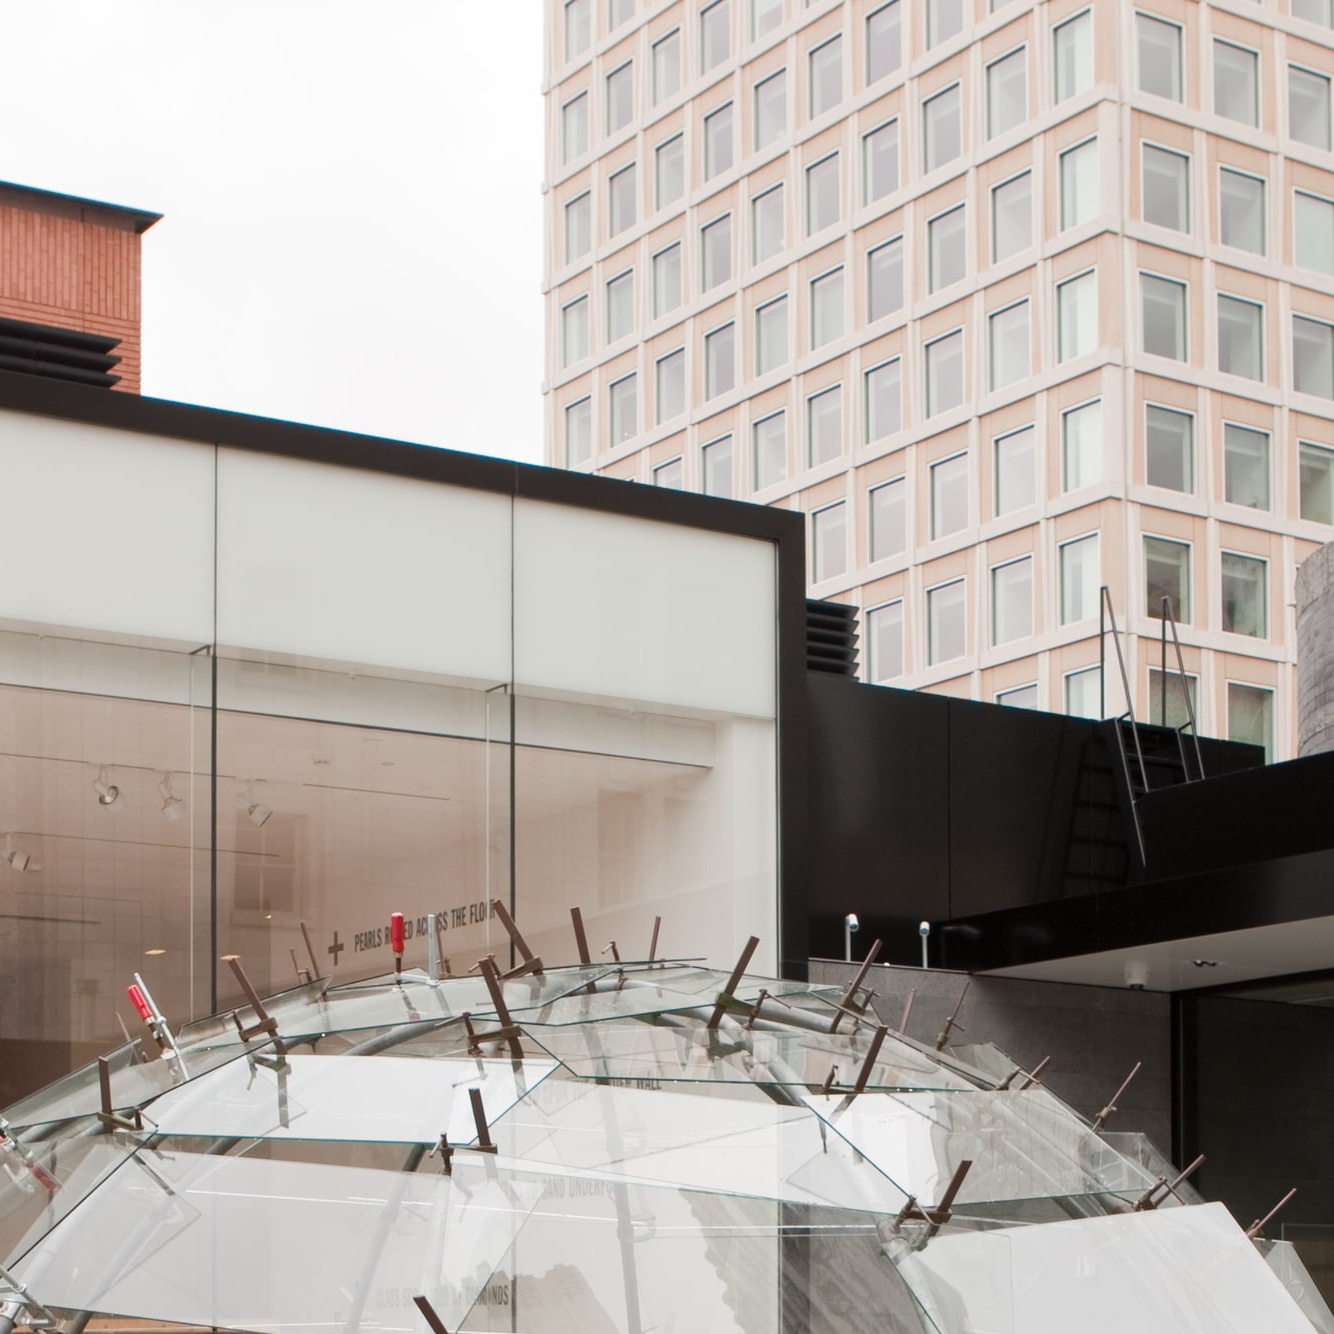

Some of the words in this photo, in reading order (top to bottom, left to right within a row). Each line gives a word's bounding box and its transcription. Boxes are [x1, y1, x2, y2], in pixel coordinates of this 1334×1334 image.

[354, 928, 382, 953] PEARLS
[416, 911, 448, 937] ACSS
[450, 906, 466, 929] THE
